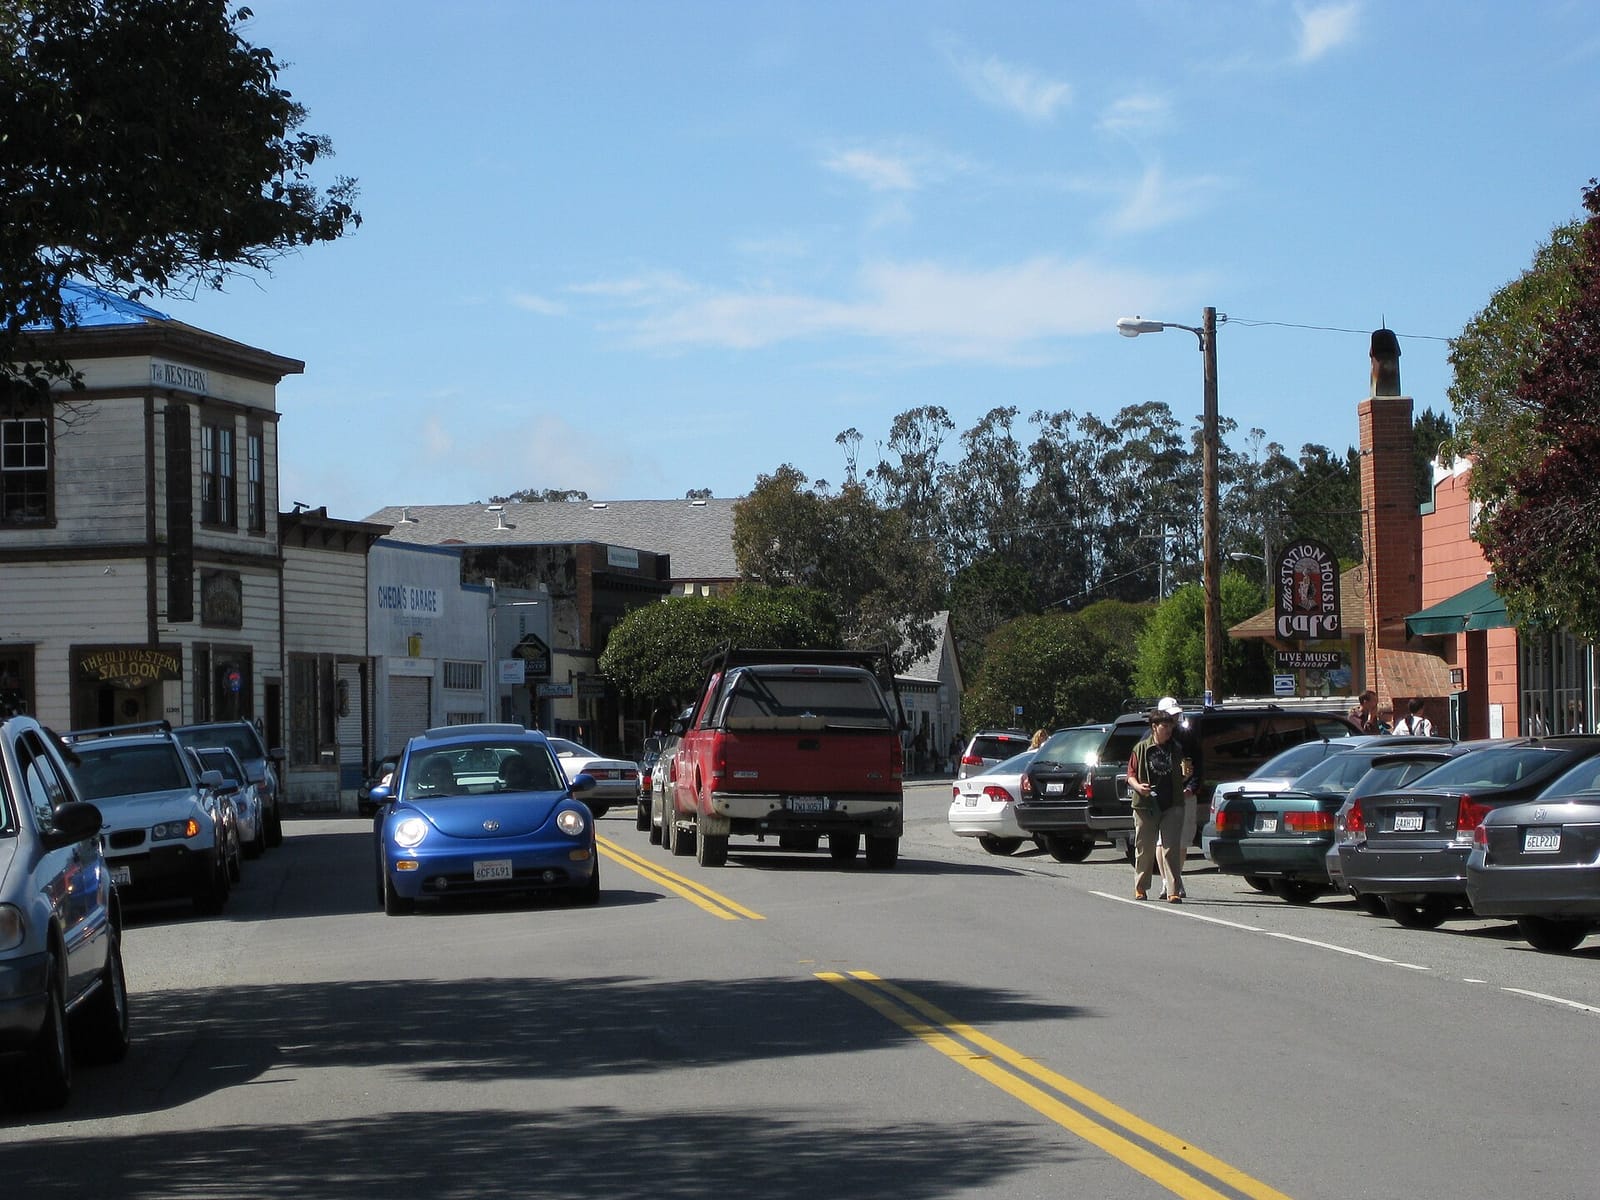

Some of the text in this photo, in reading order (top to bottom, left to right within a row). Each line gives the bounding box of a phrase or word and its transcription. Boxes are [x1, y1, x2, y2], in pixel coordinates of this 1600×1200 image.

[164, 364, 206, 391] WESTERN
[1281, 545, 1326, 586] STATION
[1320, 561, 1335, 612] HOUSE
[377, 584, 437, 612] CHEDA'S GARAGE
[80, 649, 180, 672] THE OLD WESTERN
[1279, 653, 1339, 662] LIVE MUSIC
[99, 662, 160, 680] SALOON
[1527, 836, 1559, 848] 6ELP210
